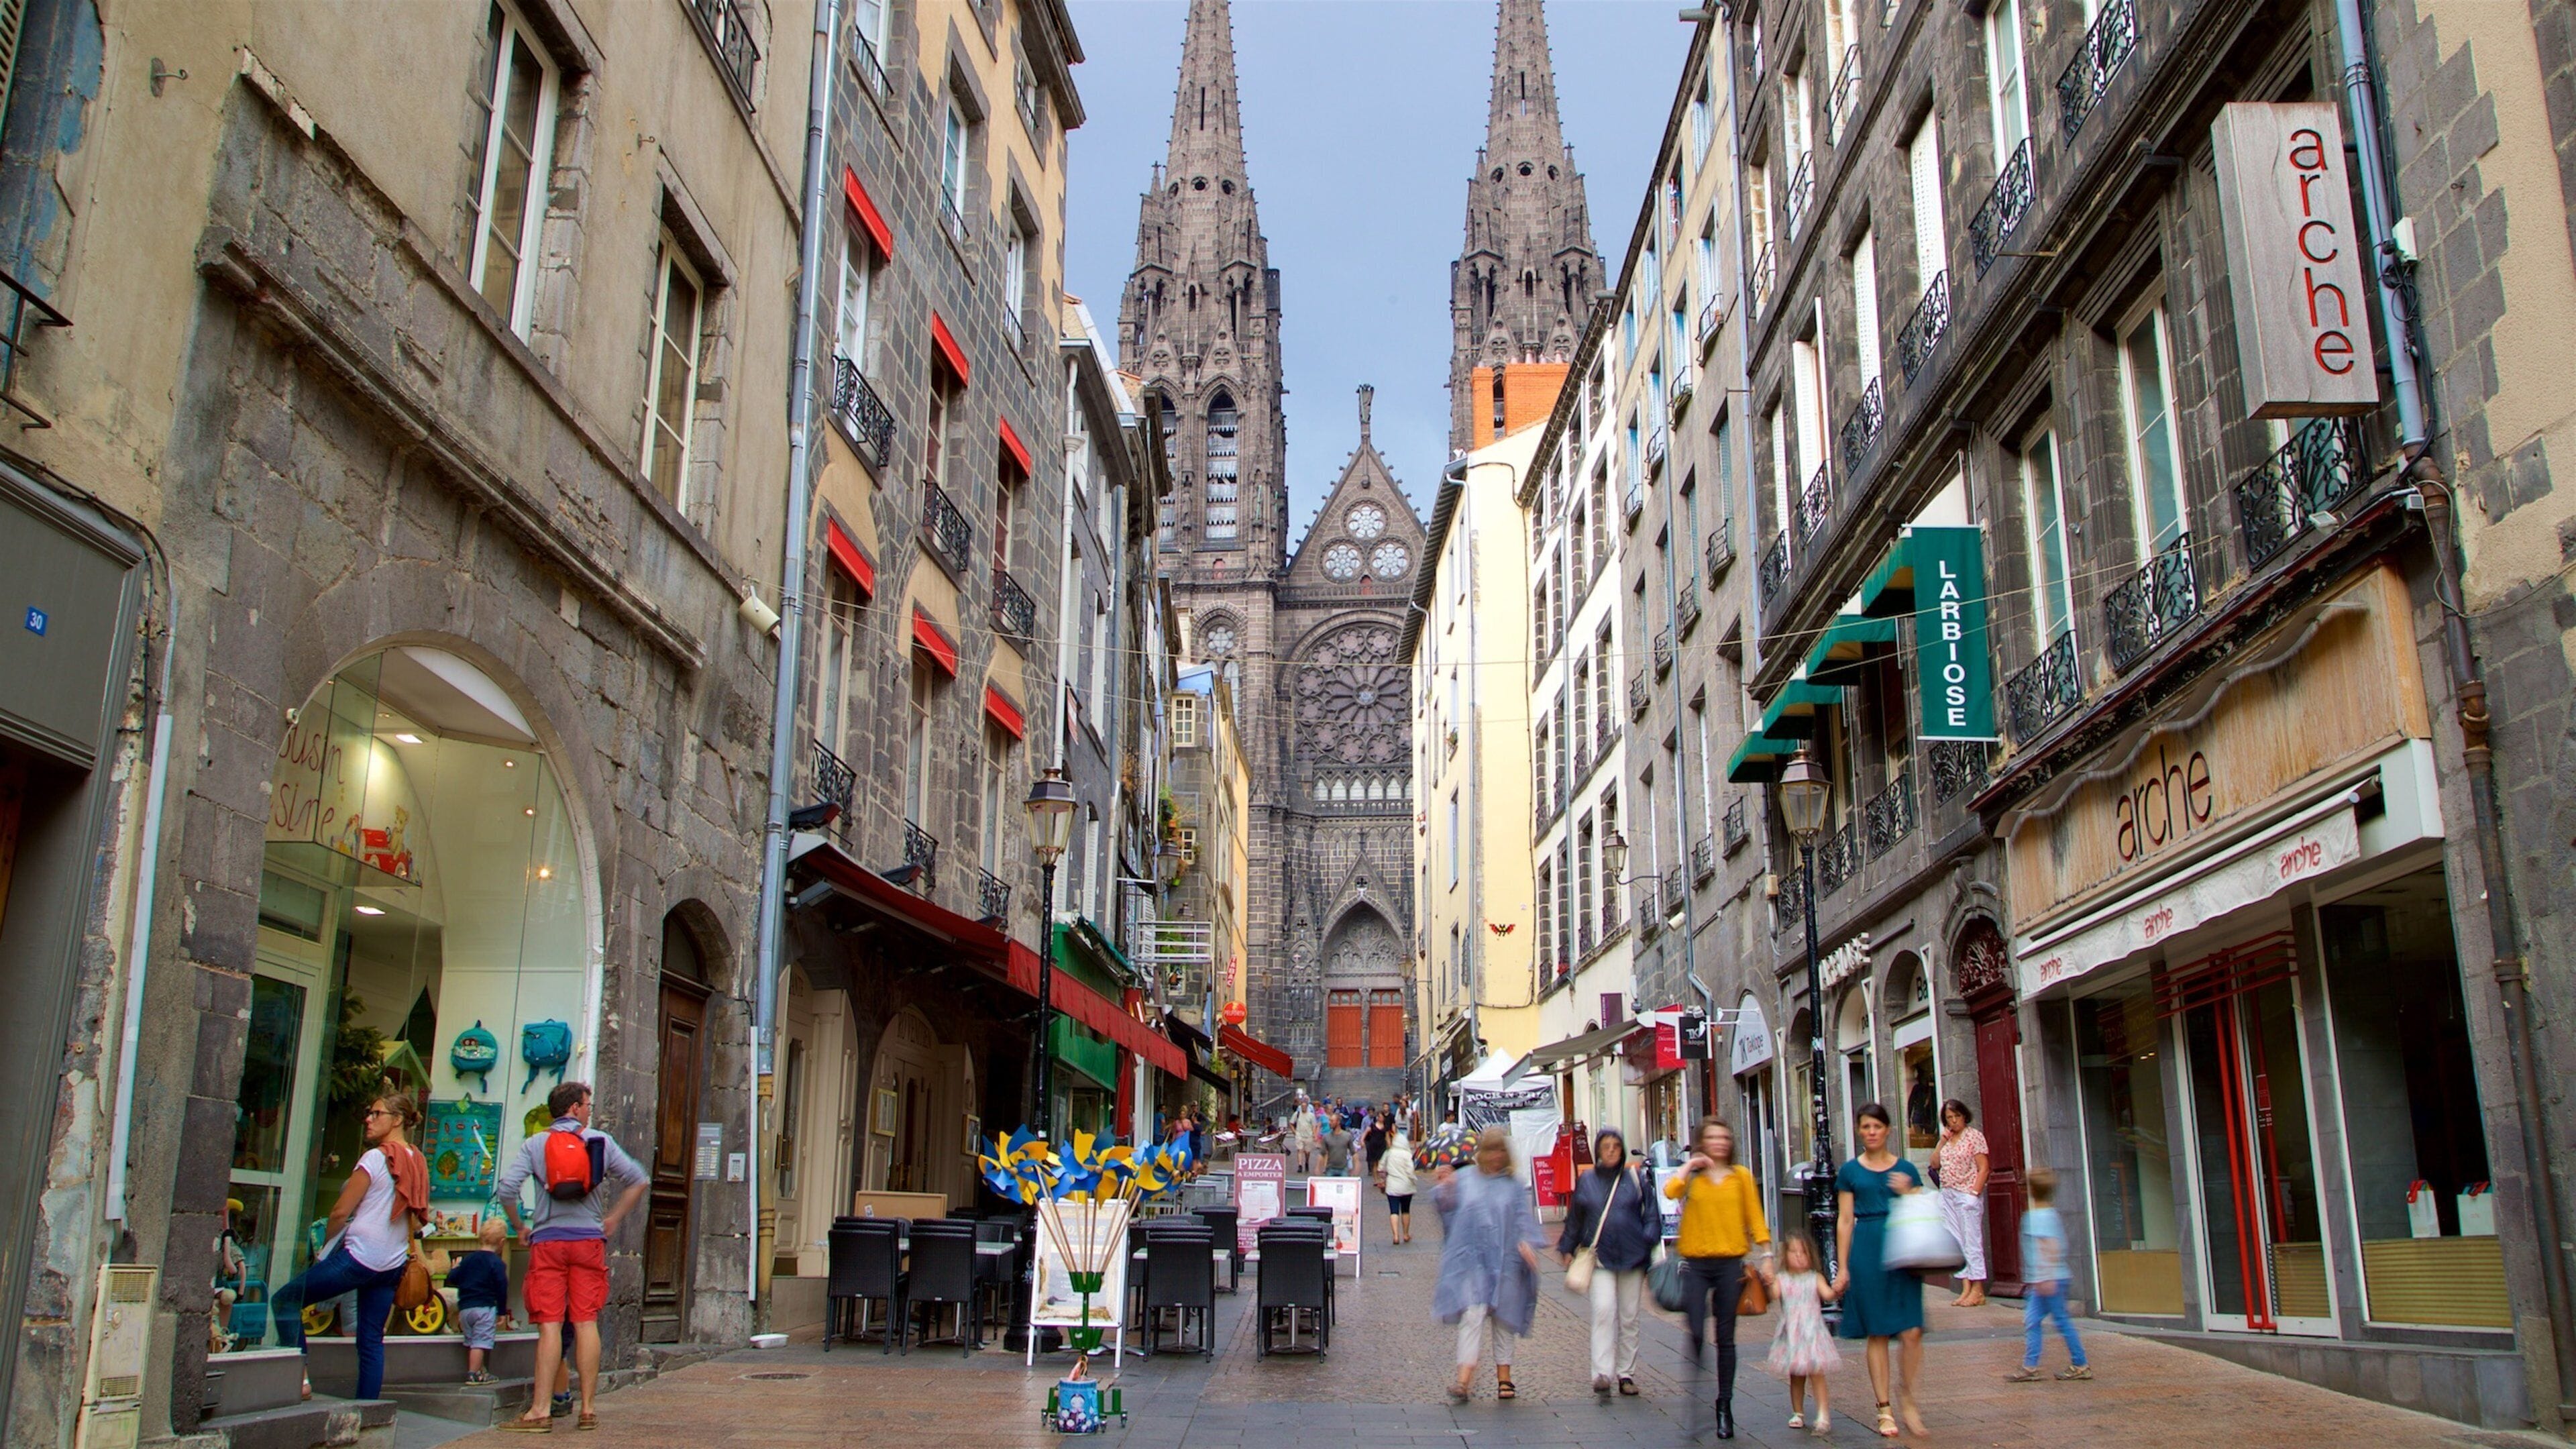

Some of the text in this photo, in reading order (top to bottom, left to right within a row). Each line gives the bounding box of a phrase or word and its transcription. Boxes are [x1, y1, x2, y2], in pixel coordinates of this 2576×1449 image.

[2290, 129, 2355, 375] arche
[30, 612, 43, 630] 30
[1939, 560, 1967, 727] LARBIOSE
[2116, 744, 2212, 862] arche
[2280, 835, 2322, 879] arche
[2144, 902, 2174, 939] arche
[2040, 953, 2063, 982] arche
[1238, 1158, 1283, 1171] PIZZA
